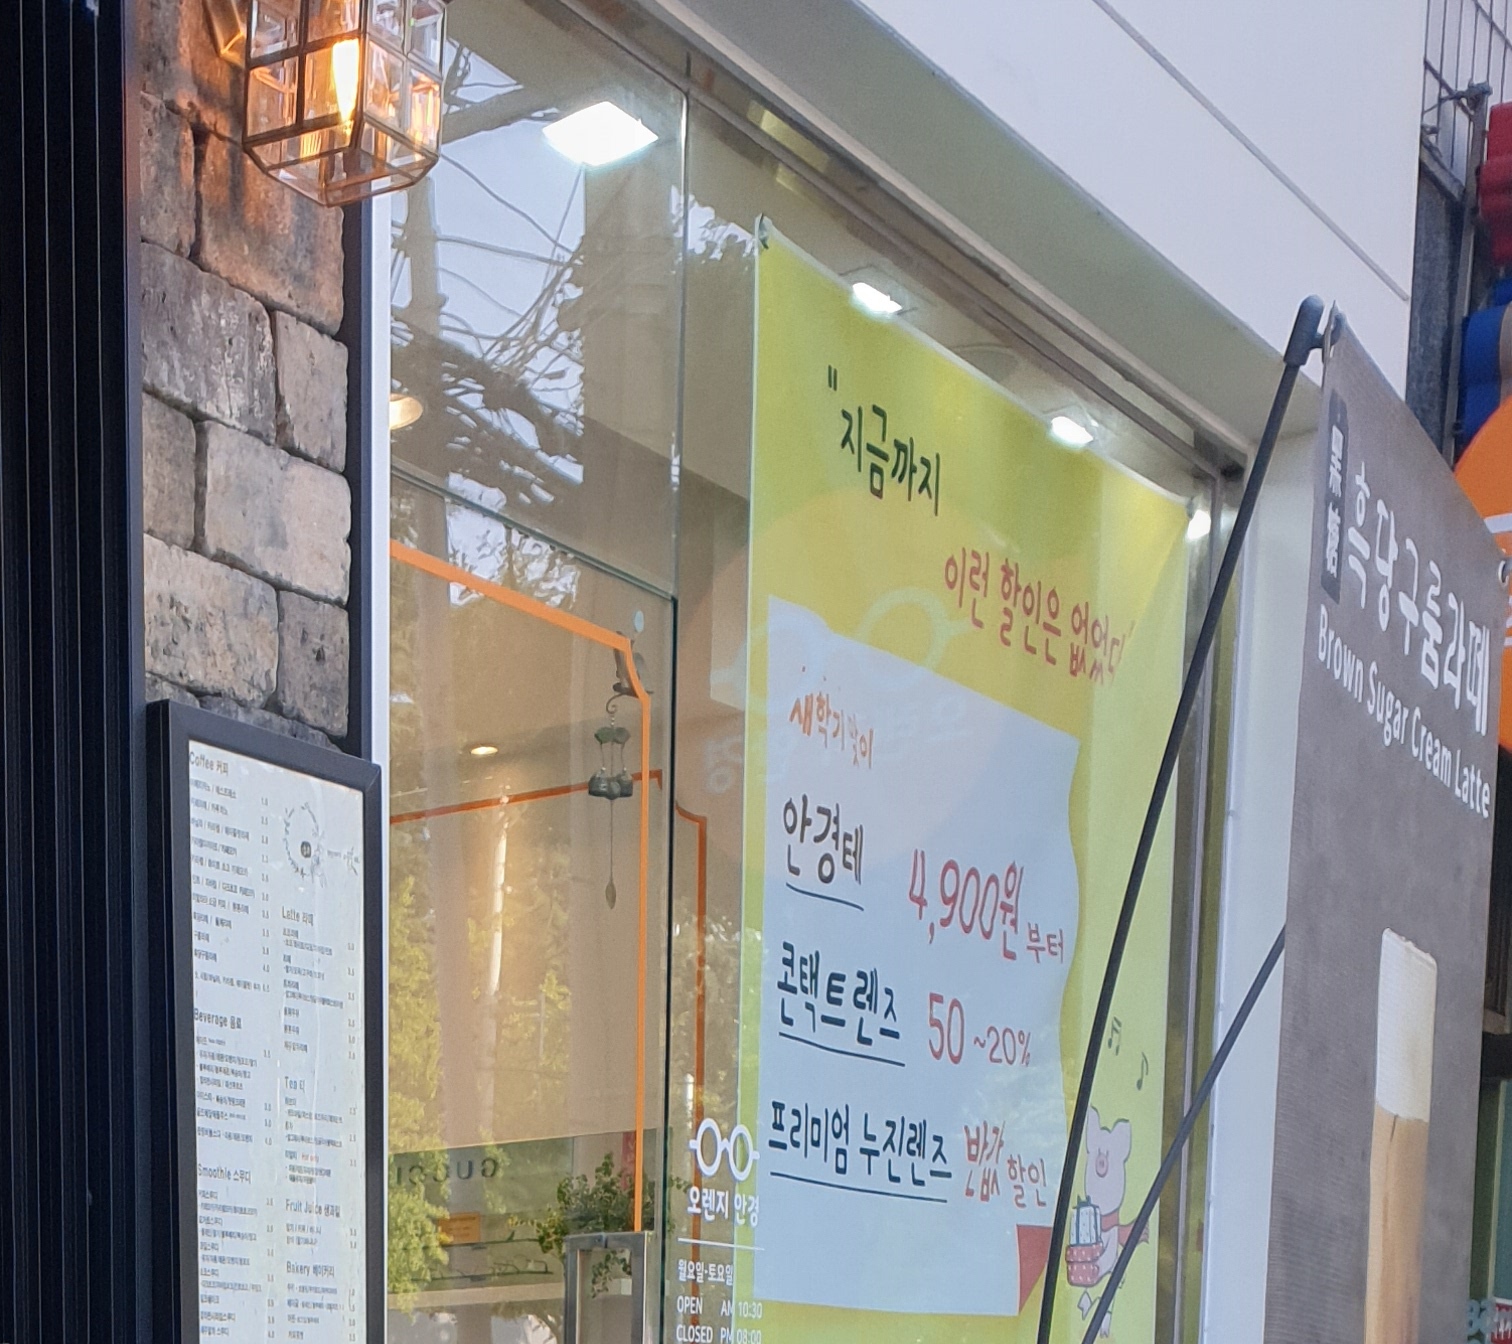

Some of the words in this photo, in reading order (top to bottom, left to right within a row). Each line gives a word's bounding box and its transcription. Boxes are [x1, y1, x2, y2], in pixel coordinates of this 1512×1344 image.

[944, 547, 989, 629] 이런
[1000, 557, 1061, 666] 할인은
[1347, 462, 1489, 736] 흑당구름라떼
[1318, 603, 1365, 705] Brown
[1367, 658, 1408, 747] Sugar
[1410, 703, 1453, 790] Cream
[1454, 748, 1490, 820] Latte
[189, 751, 214, 771] Coffee
[783, 794, 863, 884] 안경테
[282, 905, 300, 923] Latte
[777, 941, 901, 1046] 콘택트렌즈
[193, 1008, 228, 1028] Beverage
[768, 1101, 850, 1175] 프리미엄
[859, 1112, 952, 1187] 누진렌즈
[198, 1163, 231, 1181] Smoothie
[233, 1168, 252, 1185] 스무디
[285, 1199, 302, 1214] Fruit
[687, 1186, 729, 1221] 오렌지
[734, 1193, 760, 1228] 안경
[286, 1260, 310, 1277] Bakery
[676, 1296, 703, 1315] OPEN
[720, 1300, 734, 1317] AM
[738, 1302, 763, 1319] 10:30
[675, 1324, 713, 1344] CLOSED
